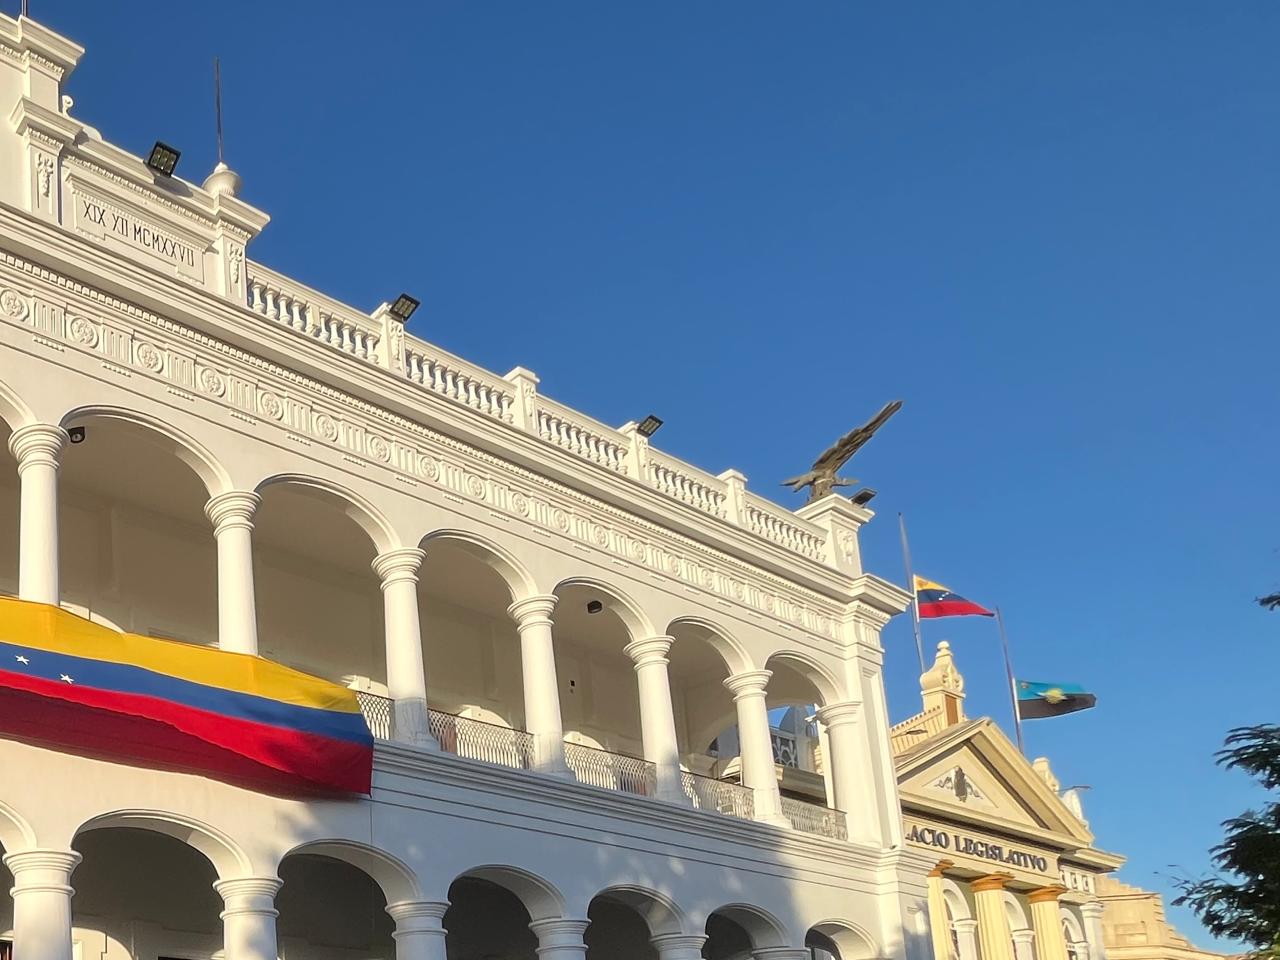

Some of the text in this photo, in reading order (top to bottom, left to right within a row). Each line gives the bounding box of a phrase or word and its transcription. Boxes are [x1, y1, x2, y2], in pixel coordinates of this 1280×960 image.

[83, 200, 195, 267] XIX XII MCMXXVII
[905, 825, 1048, 872] ACIO LEGISLATIVO
